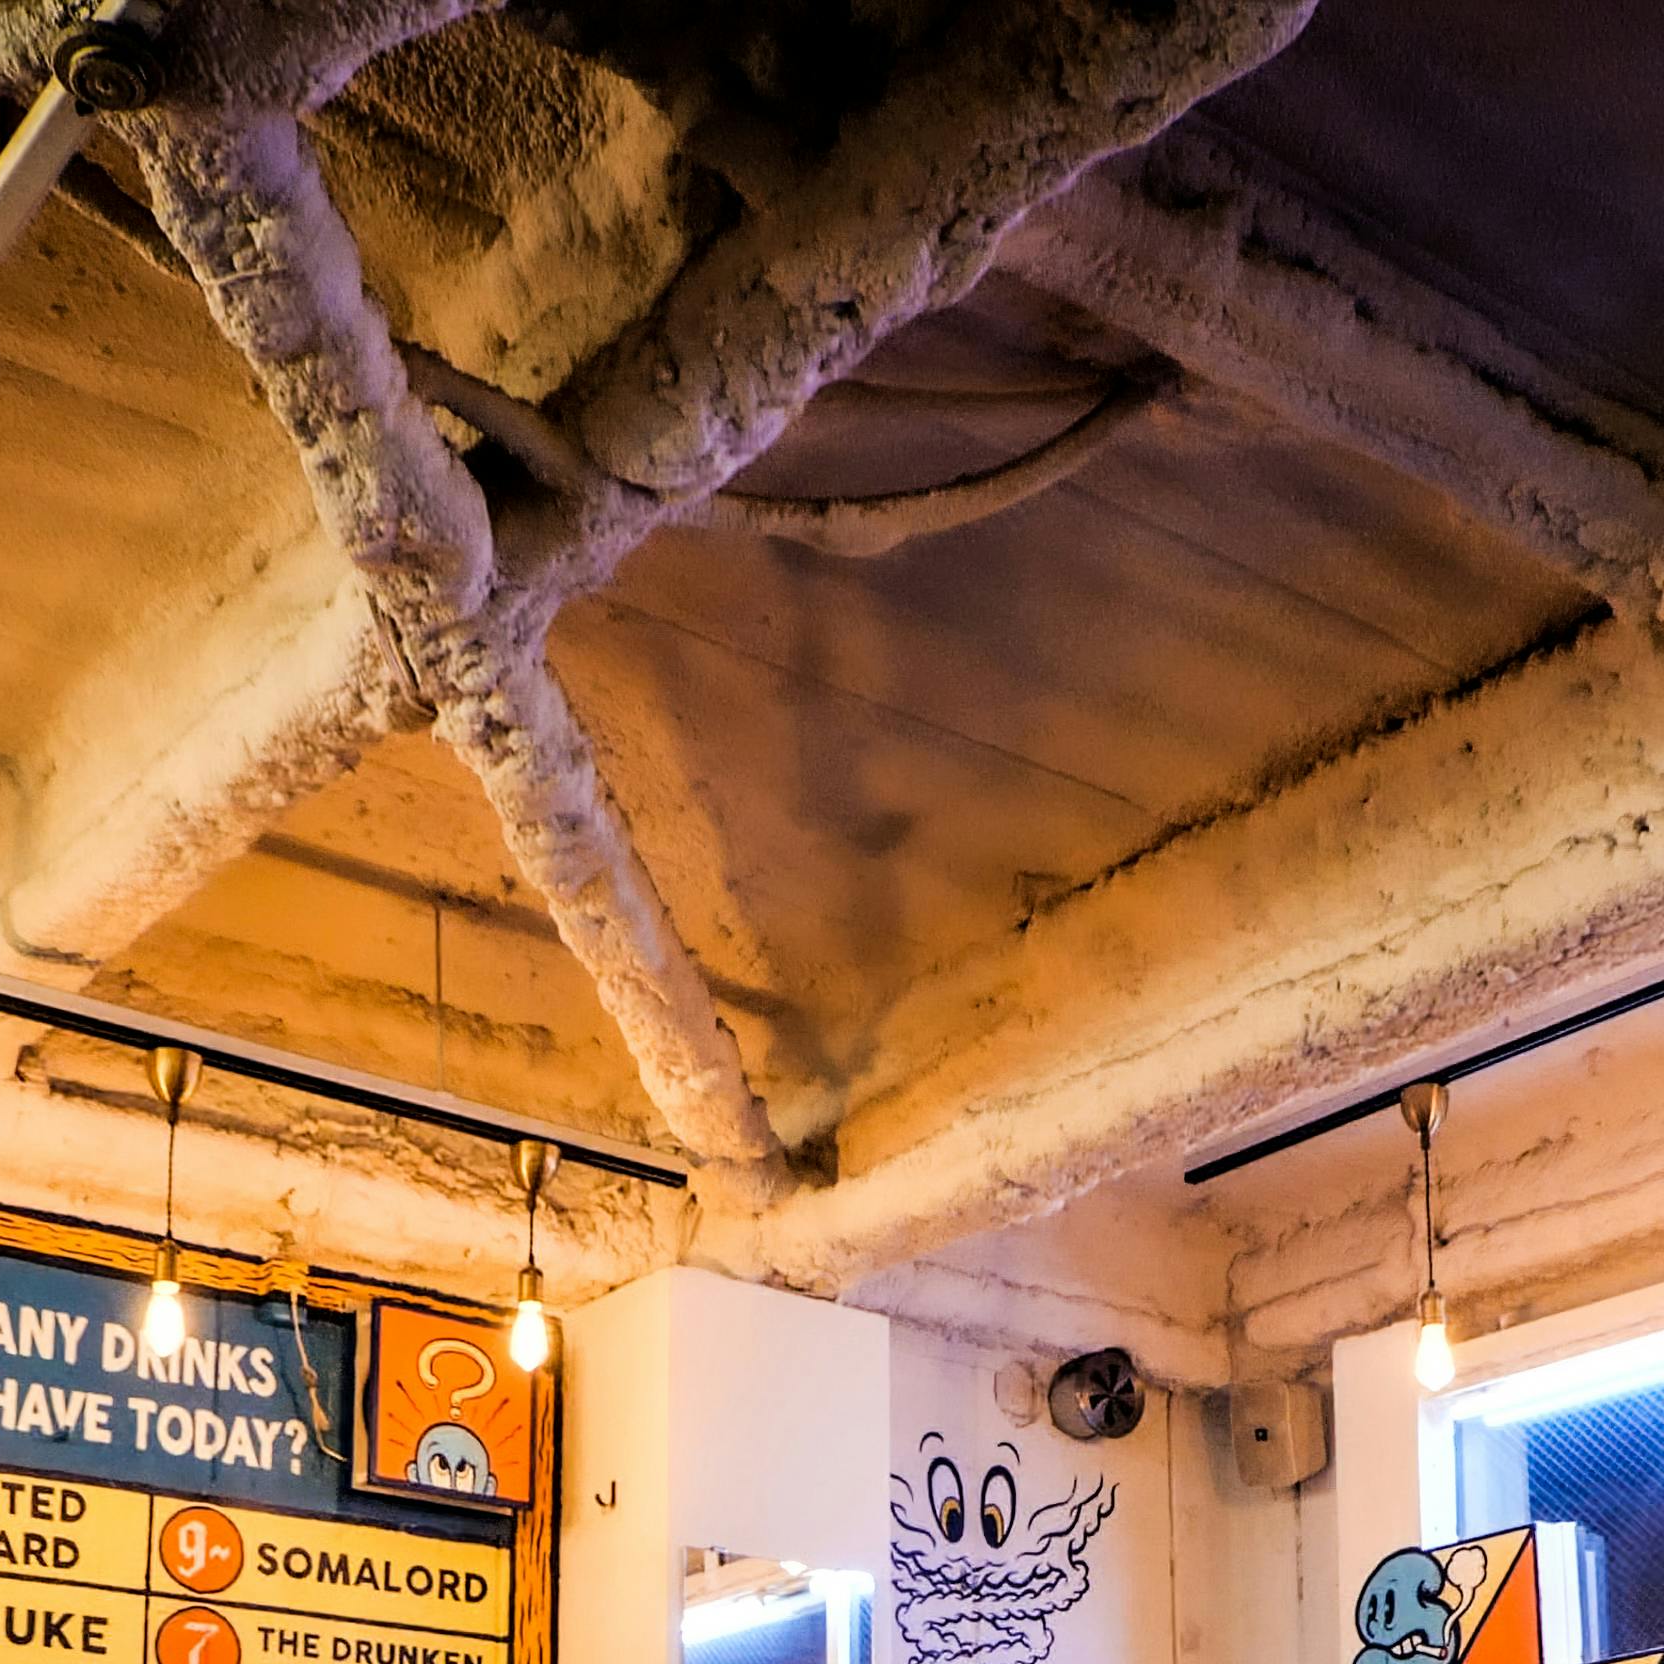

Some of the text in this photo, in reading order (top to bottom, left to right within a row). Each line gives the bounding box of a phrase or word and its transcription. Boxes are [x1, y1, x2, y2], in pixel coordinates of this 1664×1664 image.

[127, 1396, 309, 1475] TODAY?
[257, 1542, 488, 1604] SOMALORD
[257, 1626, 321, 1659] THE
